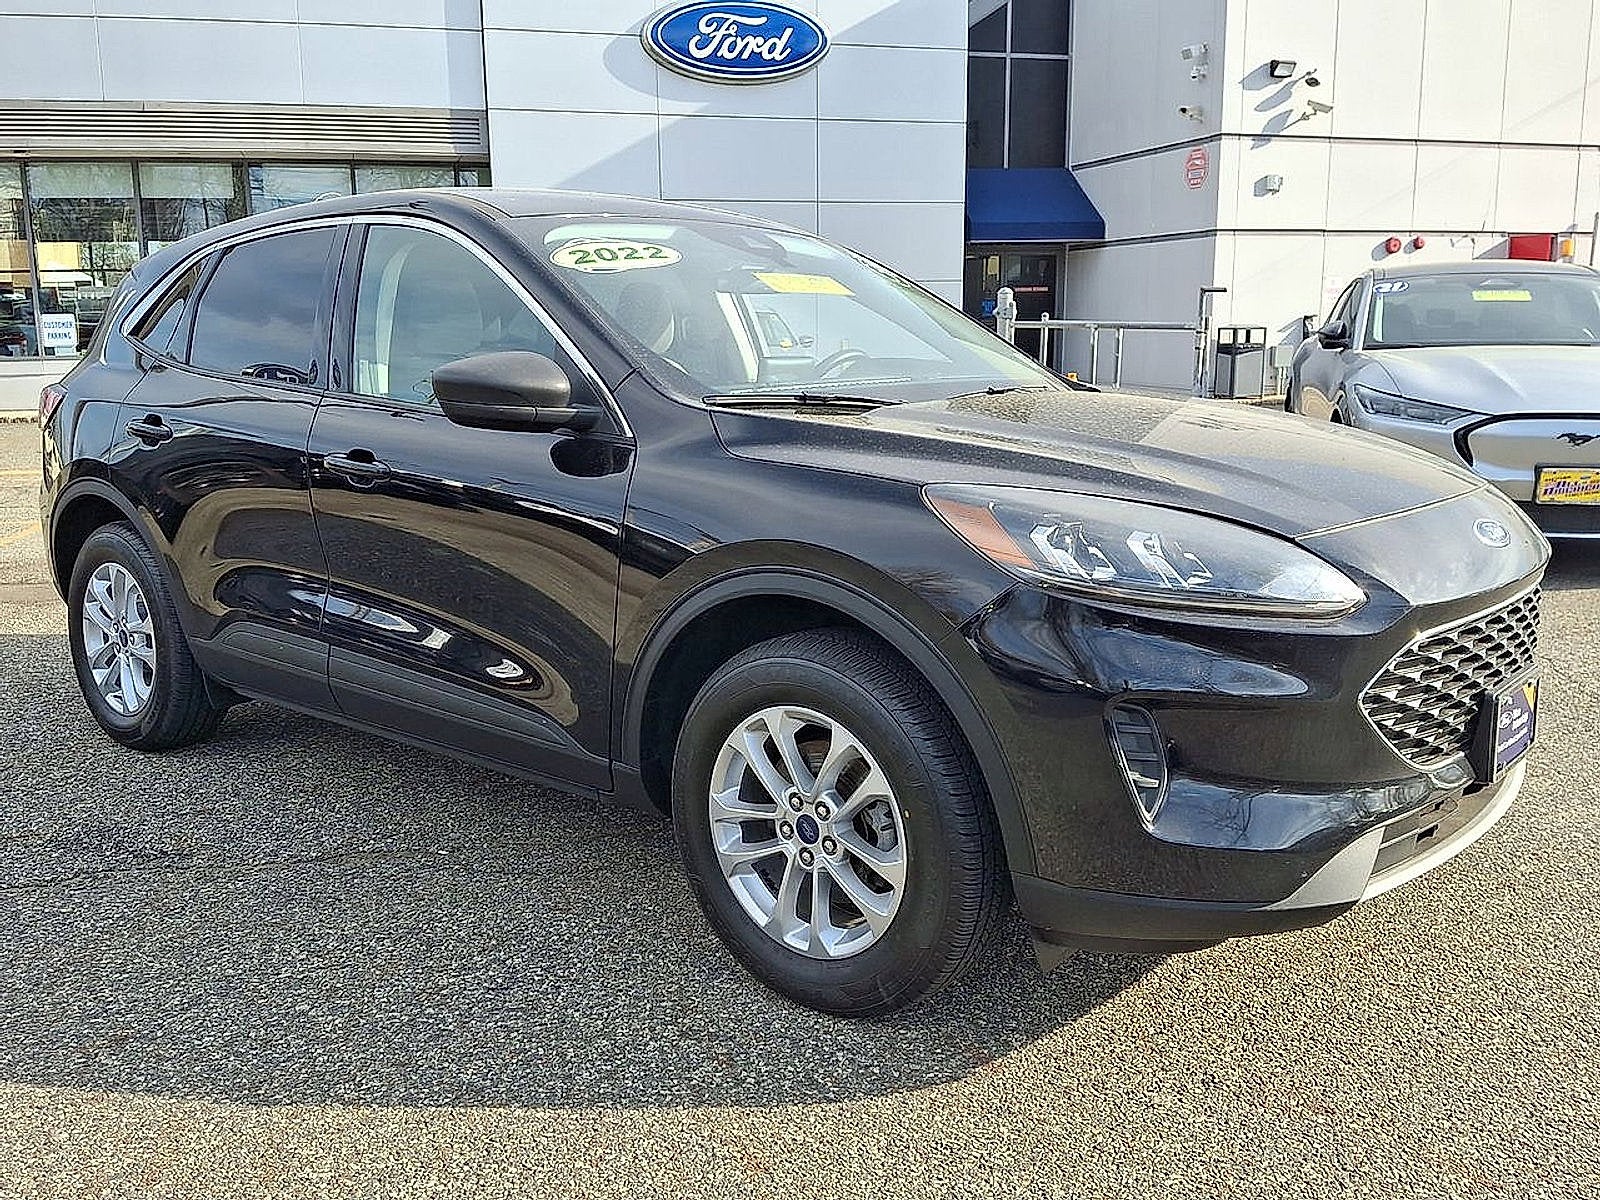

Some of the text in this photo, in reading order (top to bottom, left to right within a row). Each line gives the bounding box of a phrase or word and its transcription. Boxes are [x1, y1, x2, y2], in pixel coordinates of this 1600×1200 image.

[688, 12, 794, 62] Ford
[568, 246, 670, 265] 2022
[43, 321, 74, 329] CUSTOMER
[47, 331, 72, 340] PARKING
